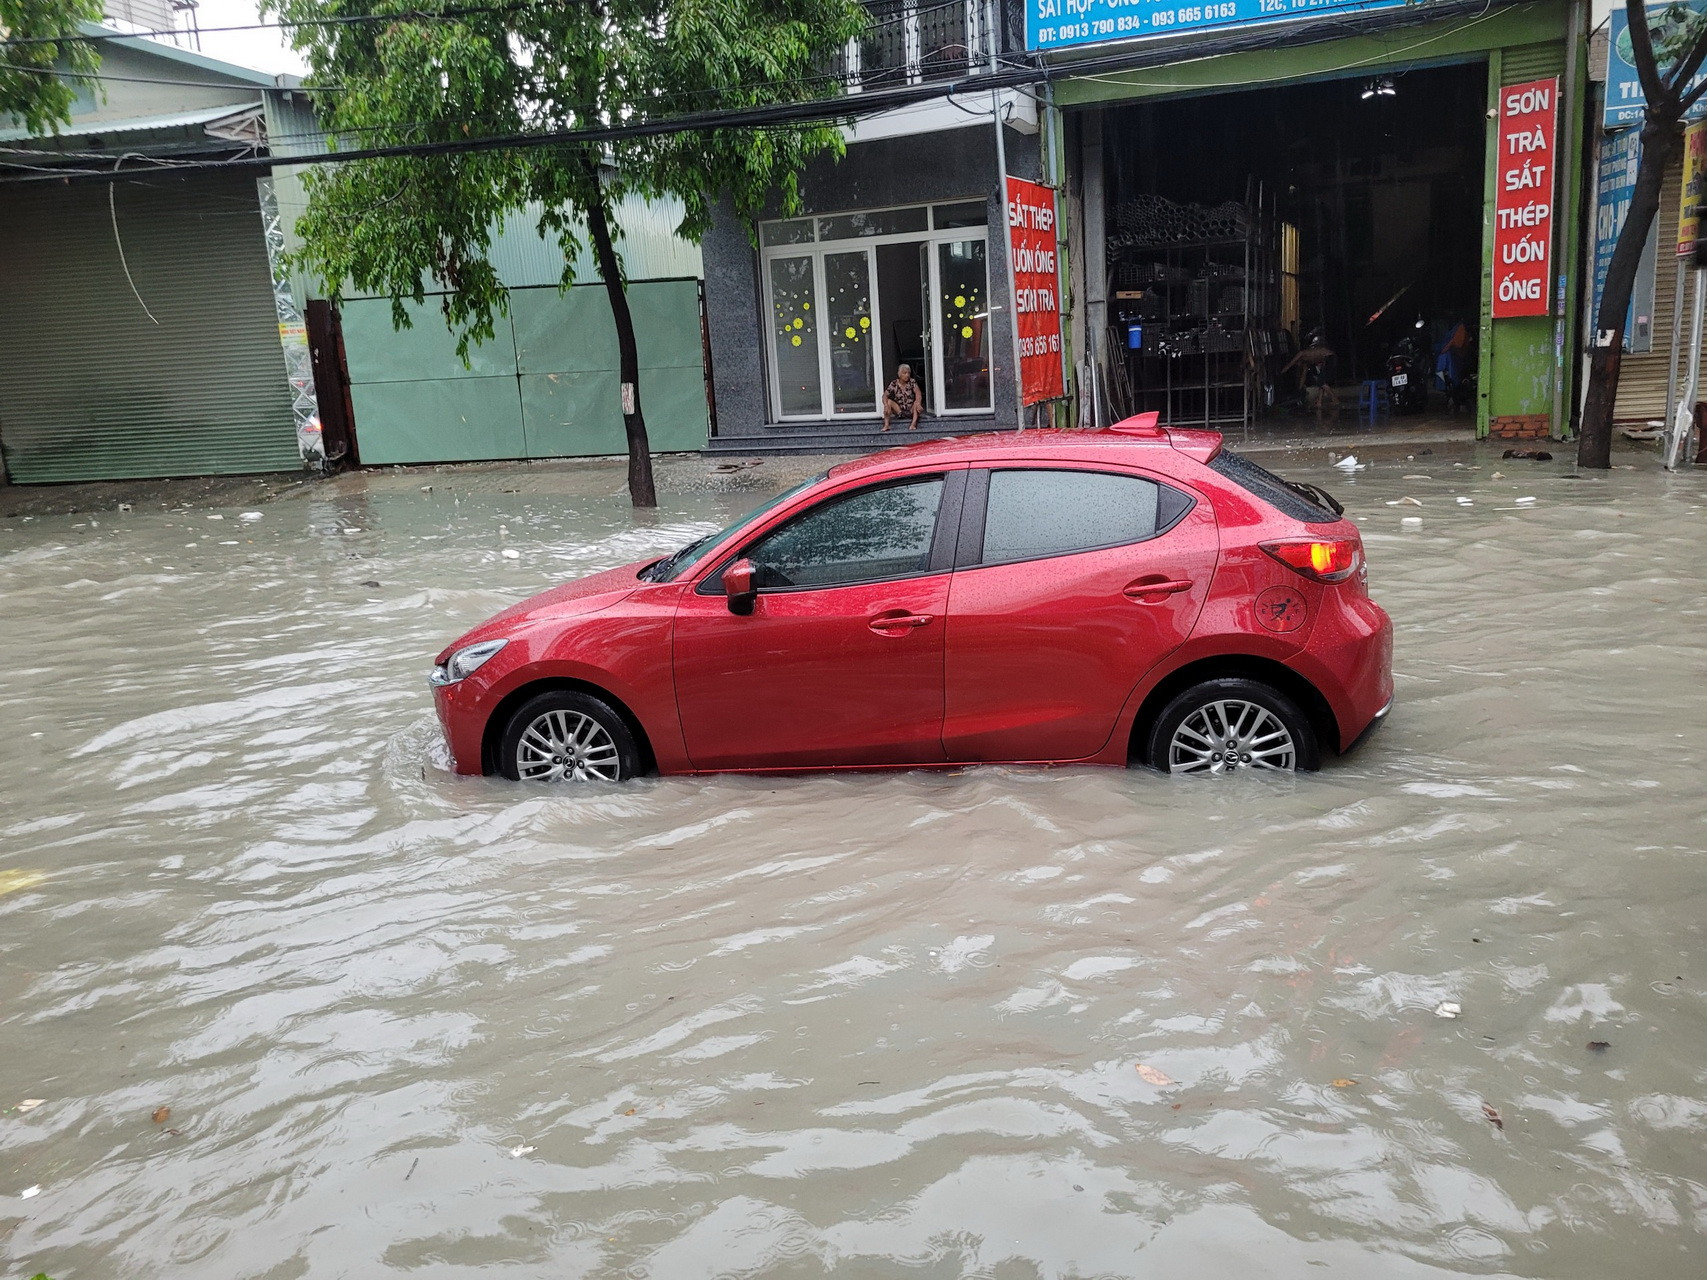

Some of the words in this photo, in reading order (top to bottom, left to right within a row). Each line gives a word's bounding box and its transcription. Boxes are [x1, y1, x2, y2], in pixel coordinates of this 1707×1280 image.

[1038, 27, 1056, 43] ĐT:
[1059, 22, 1089, 40] 0913
[1091, 18, 1115, 35] 790
[1117, 15, 1140, 31] 834
[1152, 10, 1175, 27] 093
[1178, 7, 1201, 23] 665
[1204, 2, 1236, 20] 6163
[1506, 87, 1549, 117] SƠN
[1506, 124, 1547, 155] TRÀ
[1505, 159, 1546, 191] SẮT
[1009, 193, 1028, 229] SẮT
[1029, 202, 1053, 231] THÉP
[1497, 200, 1549, 229] THÉP
[1013, 239, 1033, 273] UỐN
[1035, 241, 1054, 273] ỐNG
[1502, 233, 1545, 264] UỐN
[1016, 285, 1038, 312] SƠN
[1037, 283, 1056, 311] TRÀ
[1498, 272, 1541, 302] ỐNG
